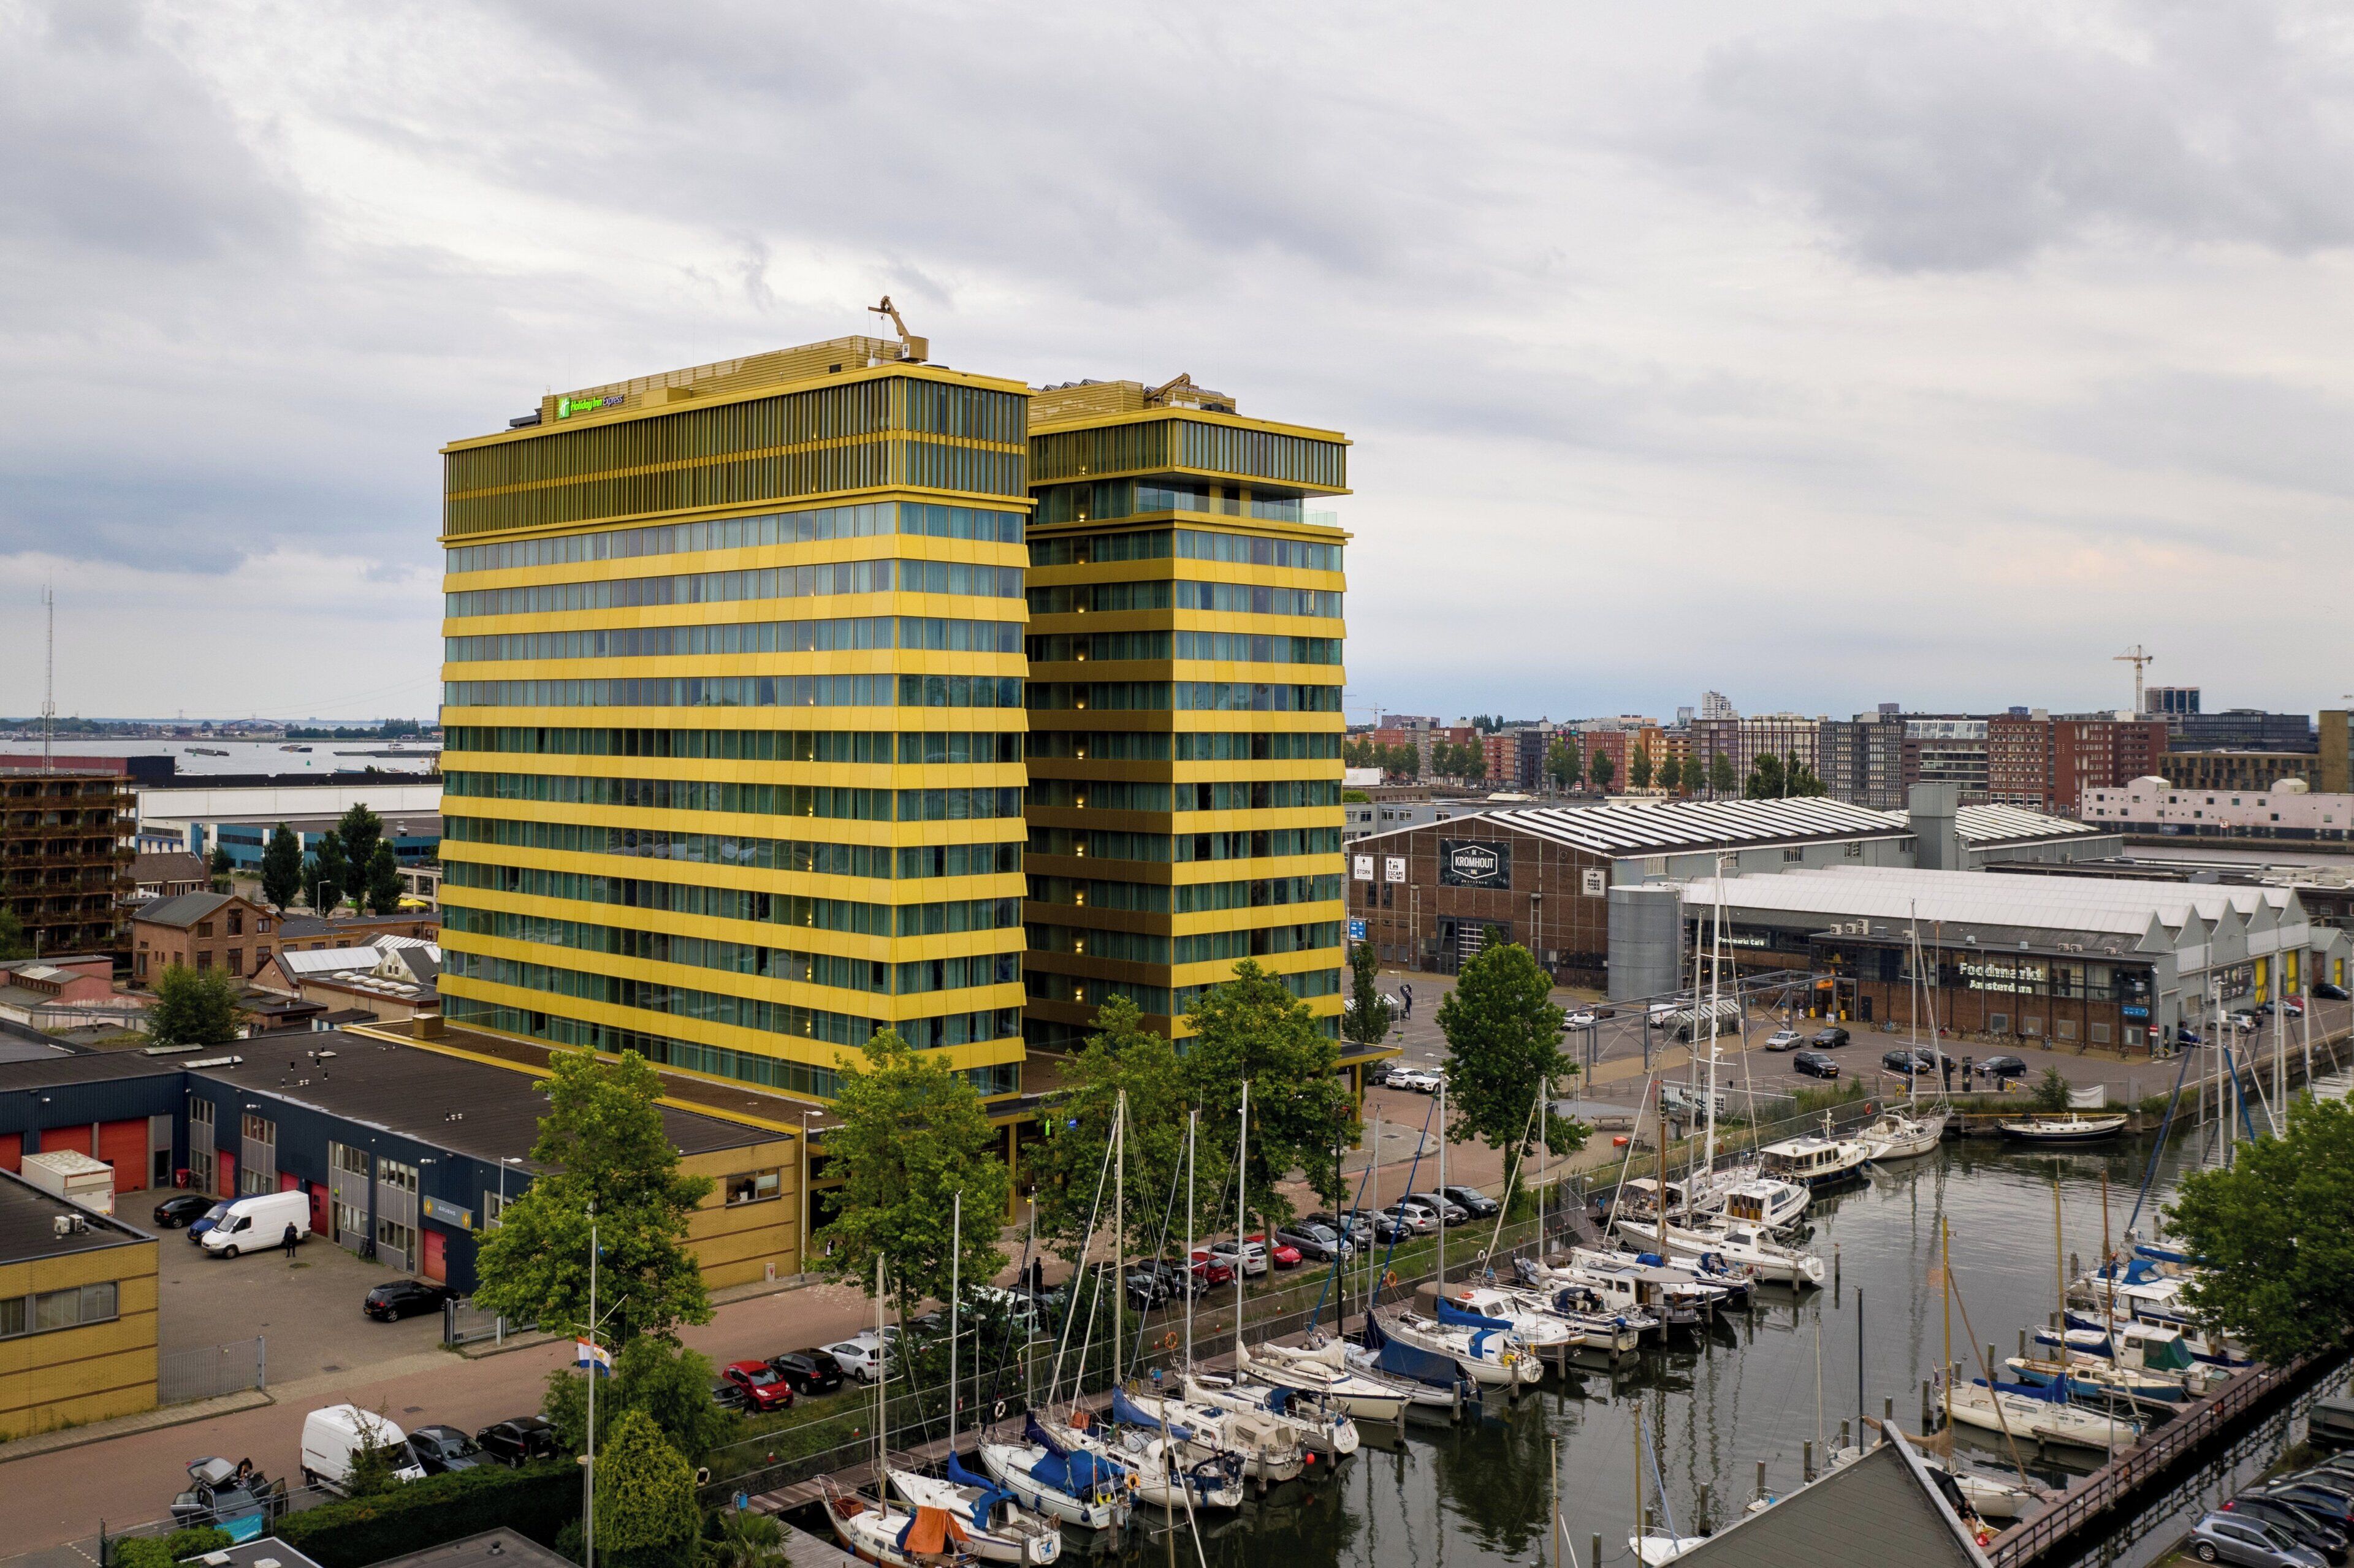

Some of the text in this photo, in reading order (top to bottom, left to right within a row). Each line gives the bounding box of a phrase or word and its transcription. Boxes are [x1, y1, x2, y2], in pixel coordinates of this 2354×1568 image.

[571, 395, 623, 411] Holiday Inn Express
[1455, 856, 1493, 868] KROMHOUT
[1959, 962, 2044, 981] Foodmarkt
